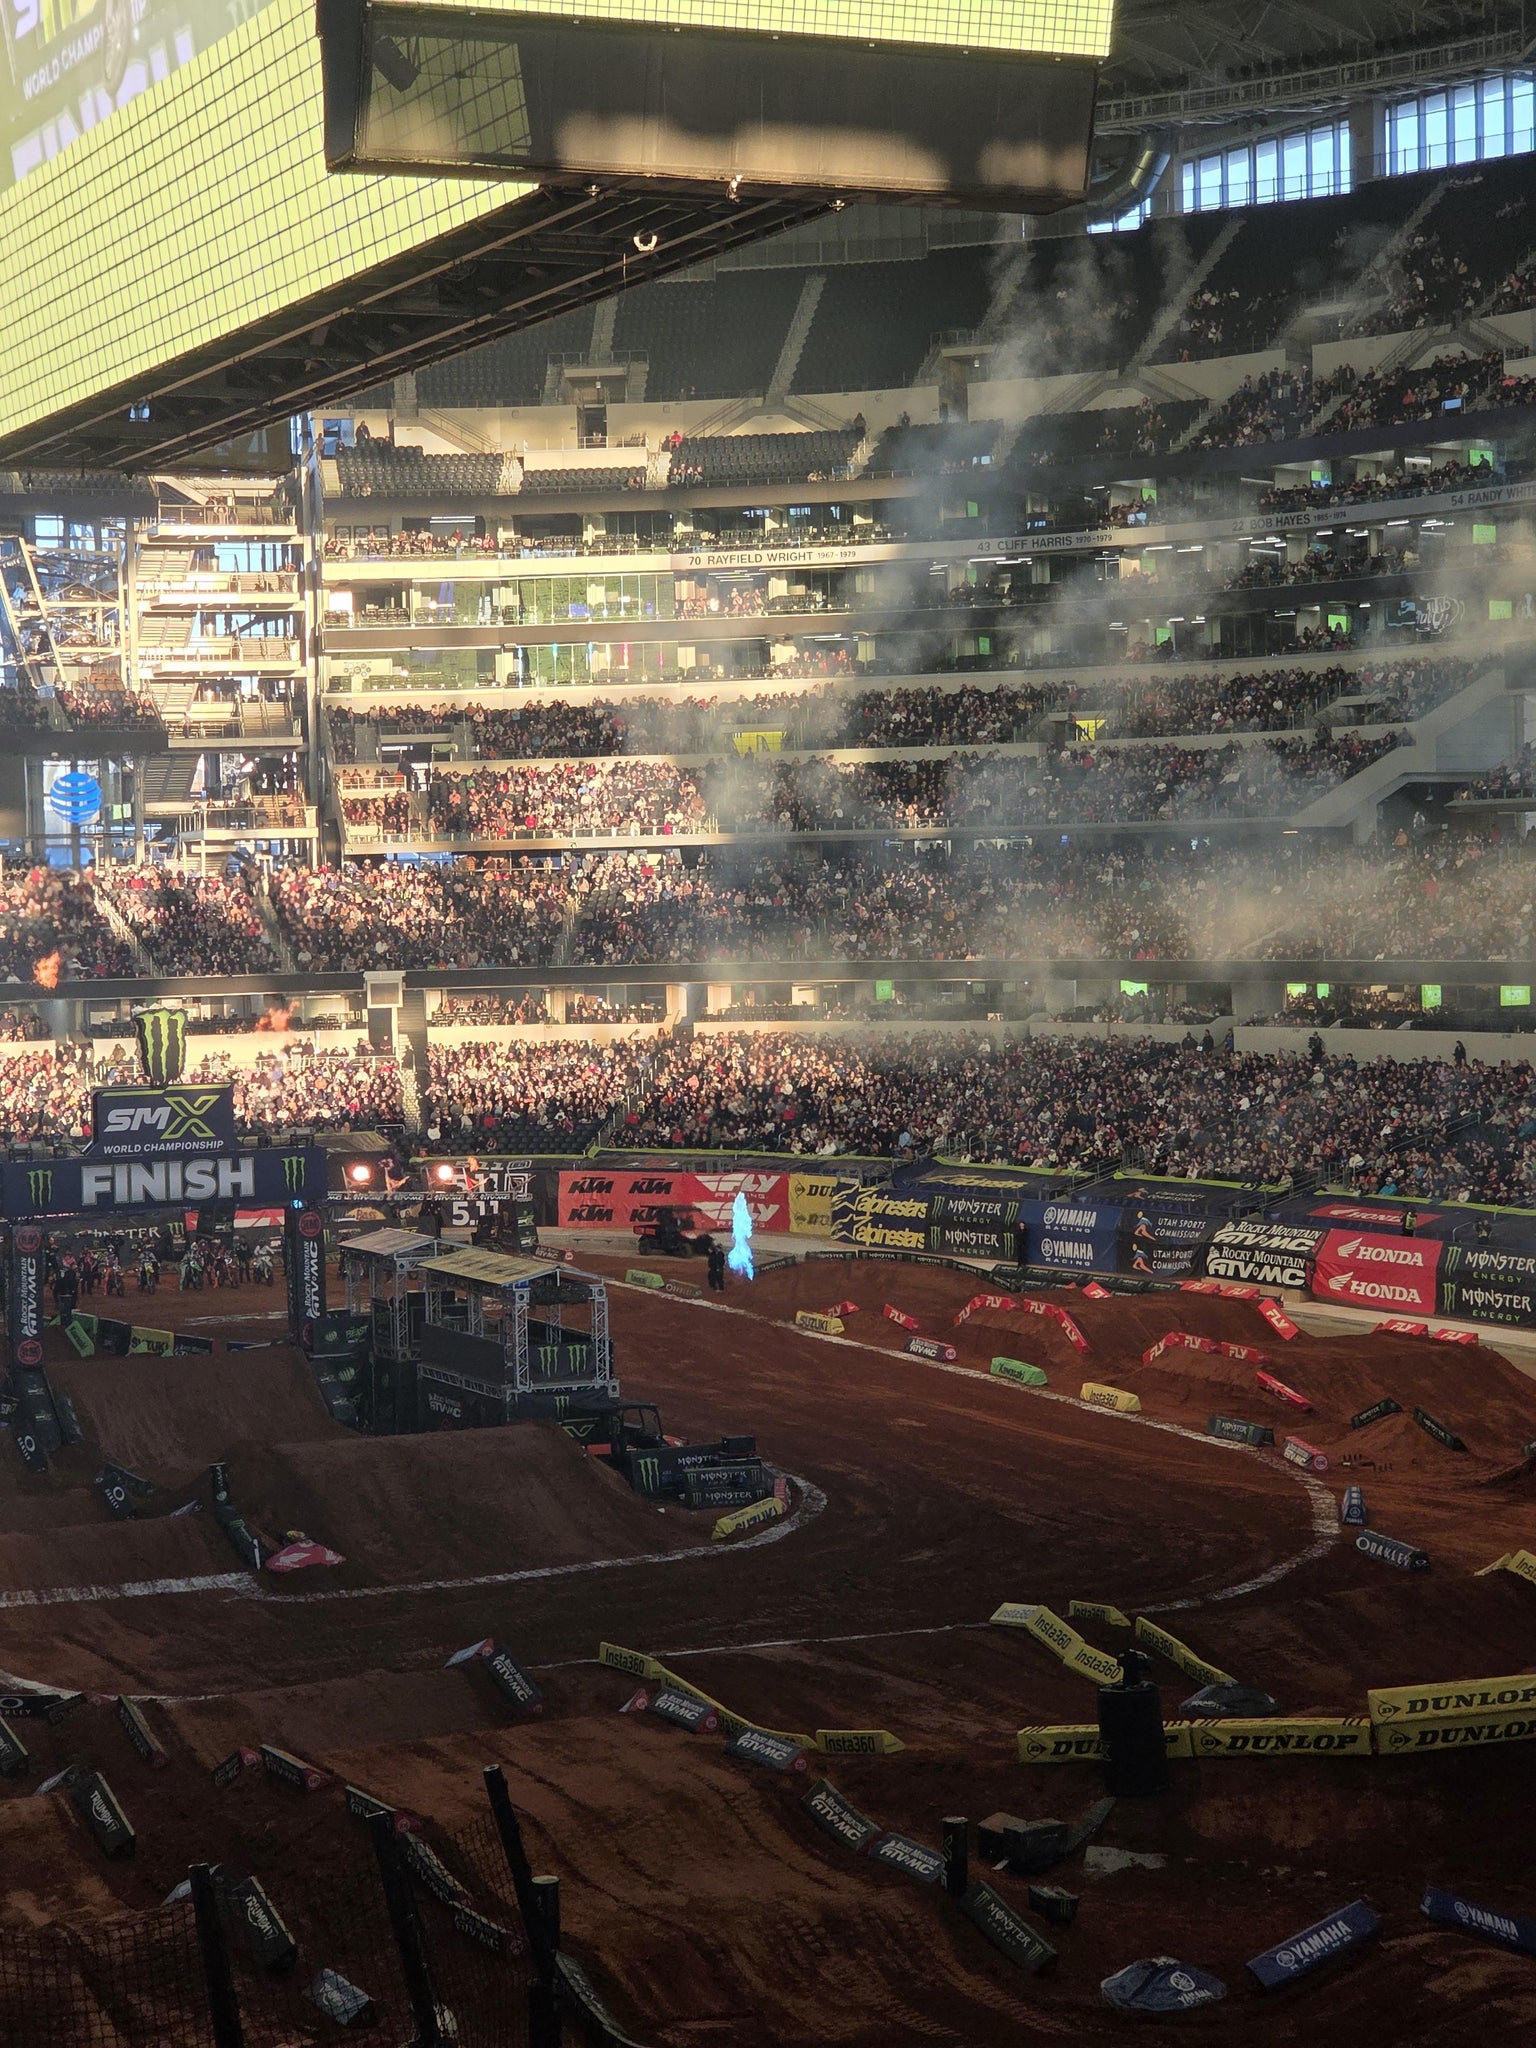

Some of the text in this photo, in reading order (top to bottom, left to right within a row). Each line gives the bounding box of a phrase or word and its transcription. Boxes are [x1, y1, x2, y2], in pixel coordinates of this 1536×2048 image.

[23, 60, 60, 101] WORLD
[1451, 495, 1465, 506] 54
[1468, 490, 1503, 504] RANDY
[1232, 521, 1244, 532] 22
[1251, 518, 1273, 530] BOB
[1275, 514, 1311, 528] HAYES
[977, 541, 991, 552] 43
[998, 539, 1028, 551] CLIFF
[1032, 536, 1073, 548] HARRIS
[688, 556, 701, 565] 70
[707, 553, 763, 565] RAYFIELD
[767, 551, 814, 562] WRIGHT
[104, 1094, 221, 1140] SMX
[104, 1140, 224, 1154] WORLD CHAMPIONSHIP
[81, 1157, 255, 1206] FINISH
[568, 1177, 614, 1194] KTM
[628, 1178, 674, 1195] KTM
[568, 1205, 614, 1222] KTM
[856, 1195, 929, 1220] alpinestars
[948, 1198, 1001, 1216] MONSTER
[953, 1215, 992, 1224] ENERGY
[1055, 1209, 1097, 1227] YAMAHA
[1158, 1218, 1206, 1229] UTAH SPORTS
[855, 1222, 926, 1250] alpinestars
[945, 1229, 1000, 1248] MONSTER
[1045, 1225, 1091, 1234] RACING
[1154, 1228, 1201, 1238] COMMISSION
[1236, 1221, 1322, 1240] ROCKY MOUNTAIN
[952, 1247, 991, 1256] ENERGY
[1052, 1239, 1094, 1260] YAMAHA
[1153, 1250, 1172, 1259] UTAH
[1222, 1246, 1306, 1267] ROCKY MOUNTAIN
[1356, 1247, 1424, 1267] HONDA
[1045, 1258, 1091, 1267] RACING
[1465, 1250, 1536, 1274] MONSTER
[1472, 1271, 1522, 1284] ENERGY
[1350, 1280, 1422, 1304] HONDA
[1461, 1287, 1532, 1313] MONSTER
[986, 1296, 1002, 1307] FLY
[1029, 1302, 1046, 1314] FLY
[799, 1314, 828, 1331] SUZUKI
[889, 1308, 907, 1323] FLY
[1266, 1308, 1290, 1329] FLY
[1471, 1309, 1521, 1323] ENERGY
[1061, 1320, 1078, 1342] FLY
[1390, 1322, 1416, 1331] FLY
[1440, 1331, 1467, 1340] FLY
[1149, 1338, 1166, 1361] FLY
[1184, 1334, 1201, 1349] FLY
[1229, 1346, 1248, 1360] FLY
[1034, 1614, 1072, 1650] Insta360
[1140, 1624, 1175, 1658] Insta360
[605, 1649, 645, 1674] Insta360
[1074, 1649, 1121, 1680] Insta360
[824, 1734, 876, 1753] Insta360
[1229, 1734, 1359, 1750] DUNLOP
[90, 1790, 117, 1830] TRIUMPH
[243, 1895, 274, 1938] TRIUMPH
[987, 1902, 1031, 1948] MONSTER
[1466, 1905, 1520, 1938] YAMAHA
[1291, 1919, 1353, 1961] YAMAHA
